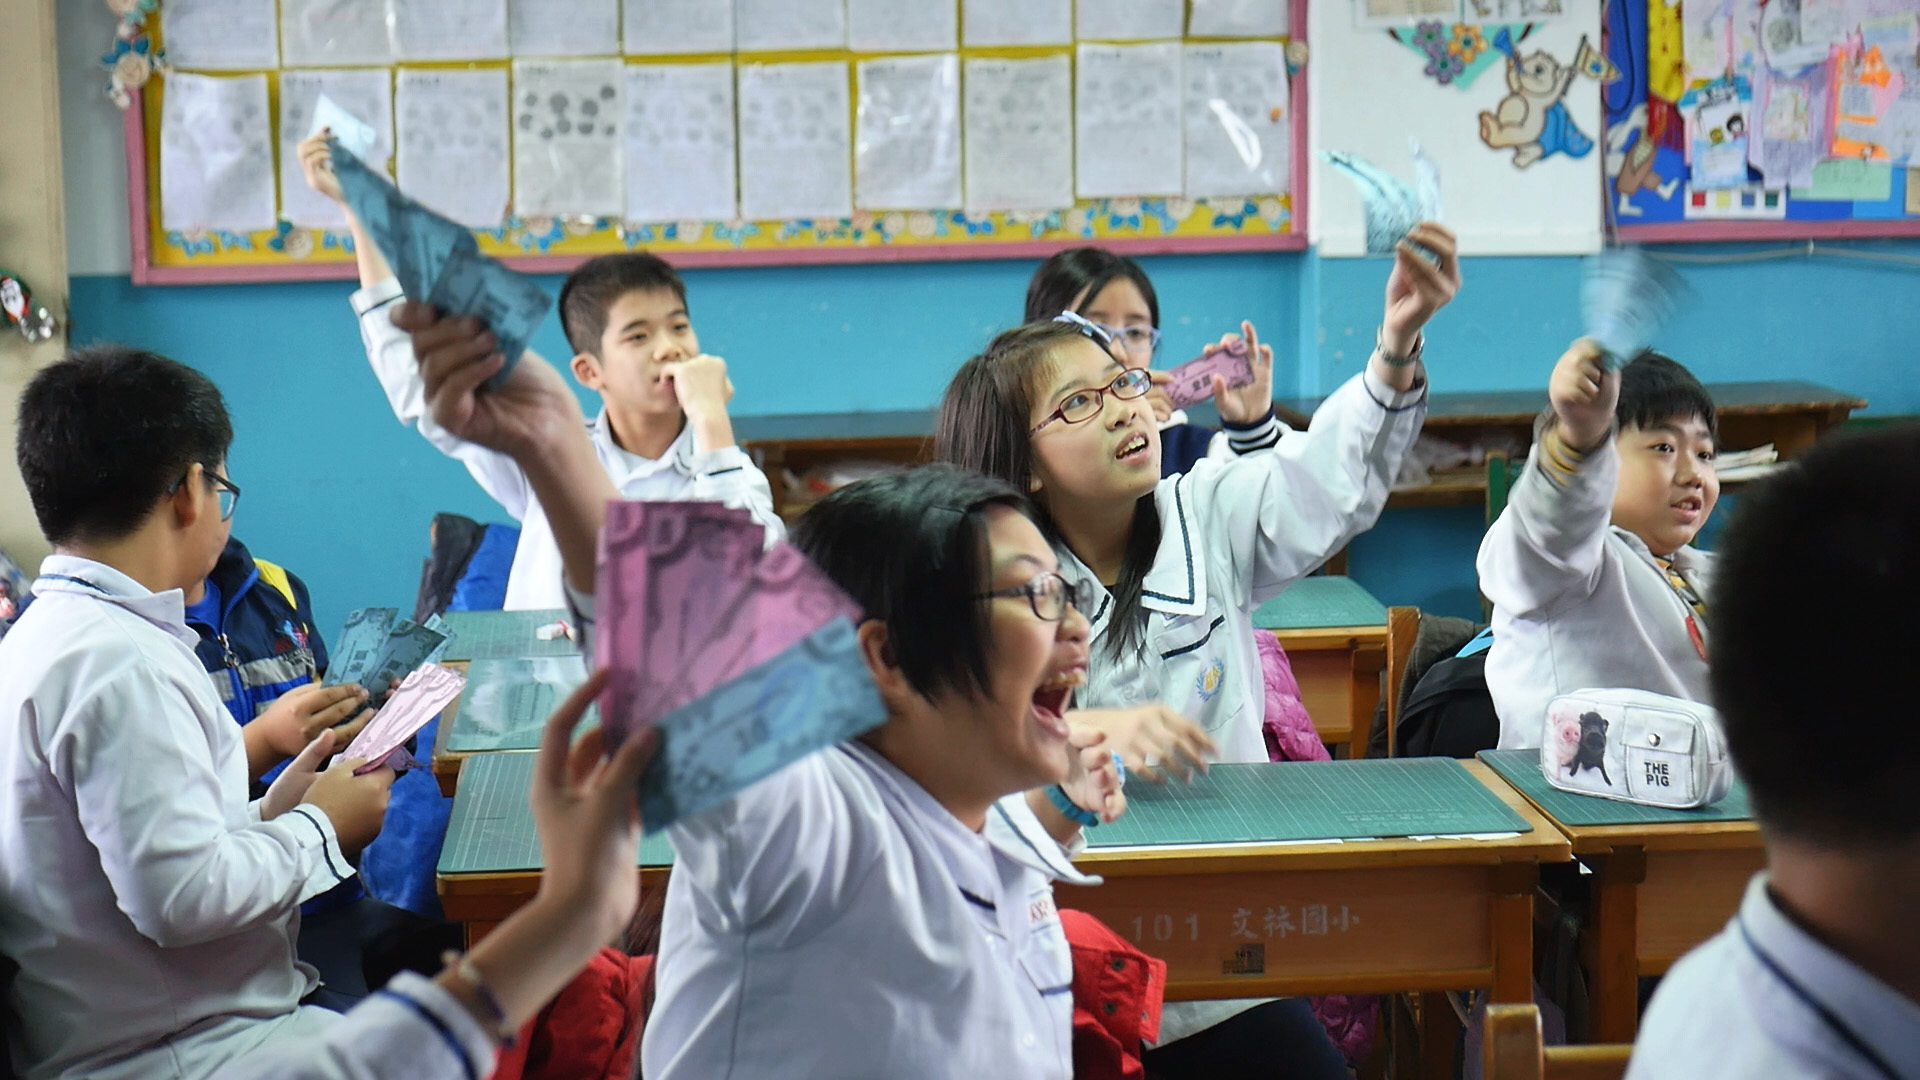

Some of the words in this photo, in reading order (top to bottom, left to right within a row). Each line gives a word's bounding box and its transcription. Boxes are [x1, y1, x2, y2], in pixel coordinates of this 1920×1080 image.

[1644, 762, 1669, 775] THE
[1646, 774, 1670, 787] PIG
[1132, 914, 1199, 941] 101
[1230, 904, 1361, 940] 文林國小
